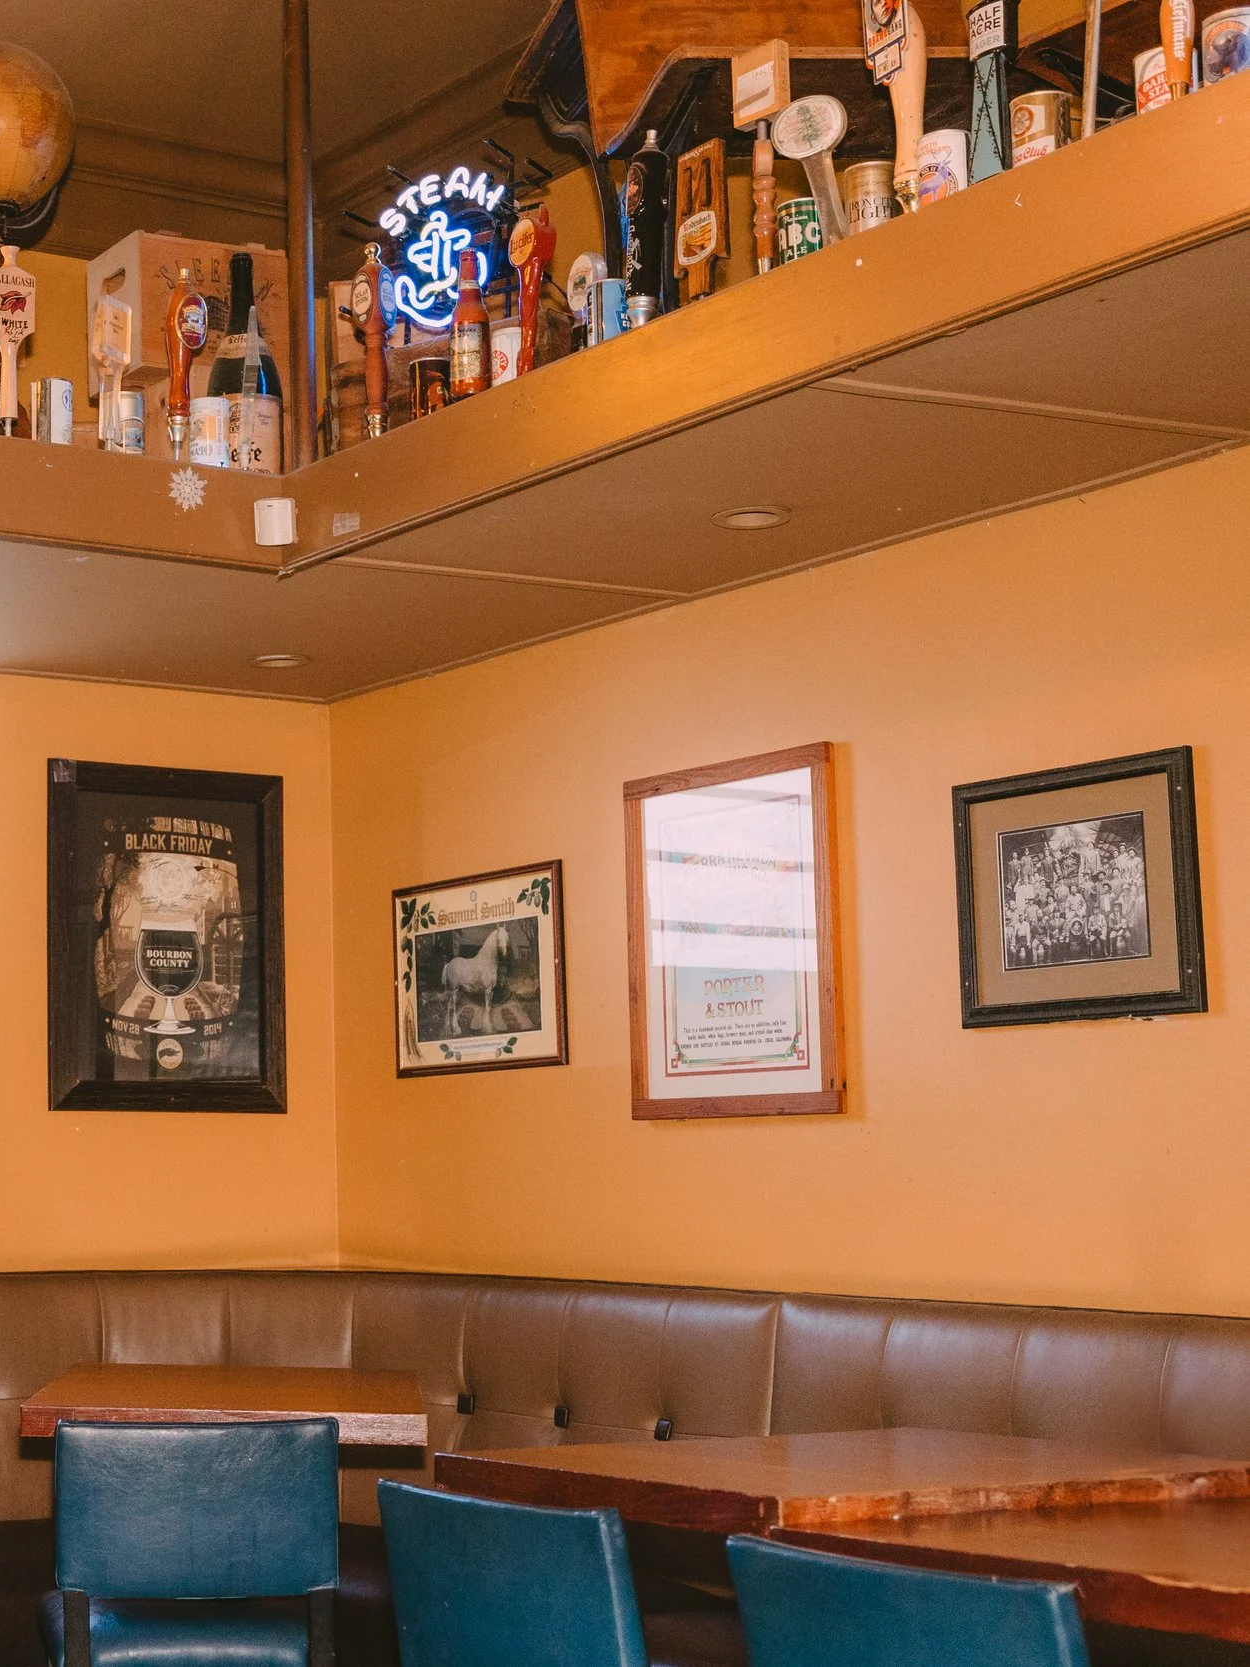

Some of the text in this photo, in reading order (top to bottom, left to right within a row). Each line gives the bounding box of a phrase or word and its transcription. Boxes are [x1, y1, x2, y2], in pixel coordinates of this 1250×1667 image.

[970, 5, 1001, 27] HALF
[970, 17, 1001, 39] ACRE
[1143, 73, 1165, 92] GAR
[1148, 83, 1170, 99] STA
[379, 166, 505, 237] STEAM
[778, 220, 822, 251] ABC
[786, 246, 808, 258] ALE
[1, 317, 28, 329] WHITE
[125, 833, 213, 855] BLACK FRIDAY
[437, 896, 515, 927] Samuel Smith
[146, 949, 193, 960] BOURBON
[149, 959, 190, 969] COUNTY
[703, 973, 766, 996] PORTER
[704, 998, 764, 1019] & STOUT
[112, 1019, 140, 1035] NOV 28
[203, 1022, 222, 1036] 2014
